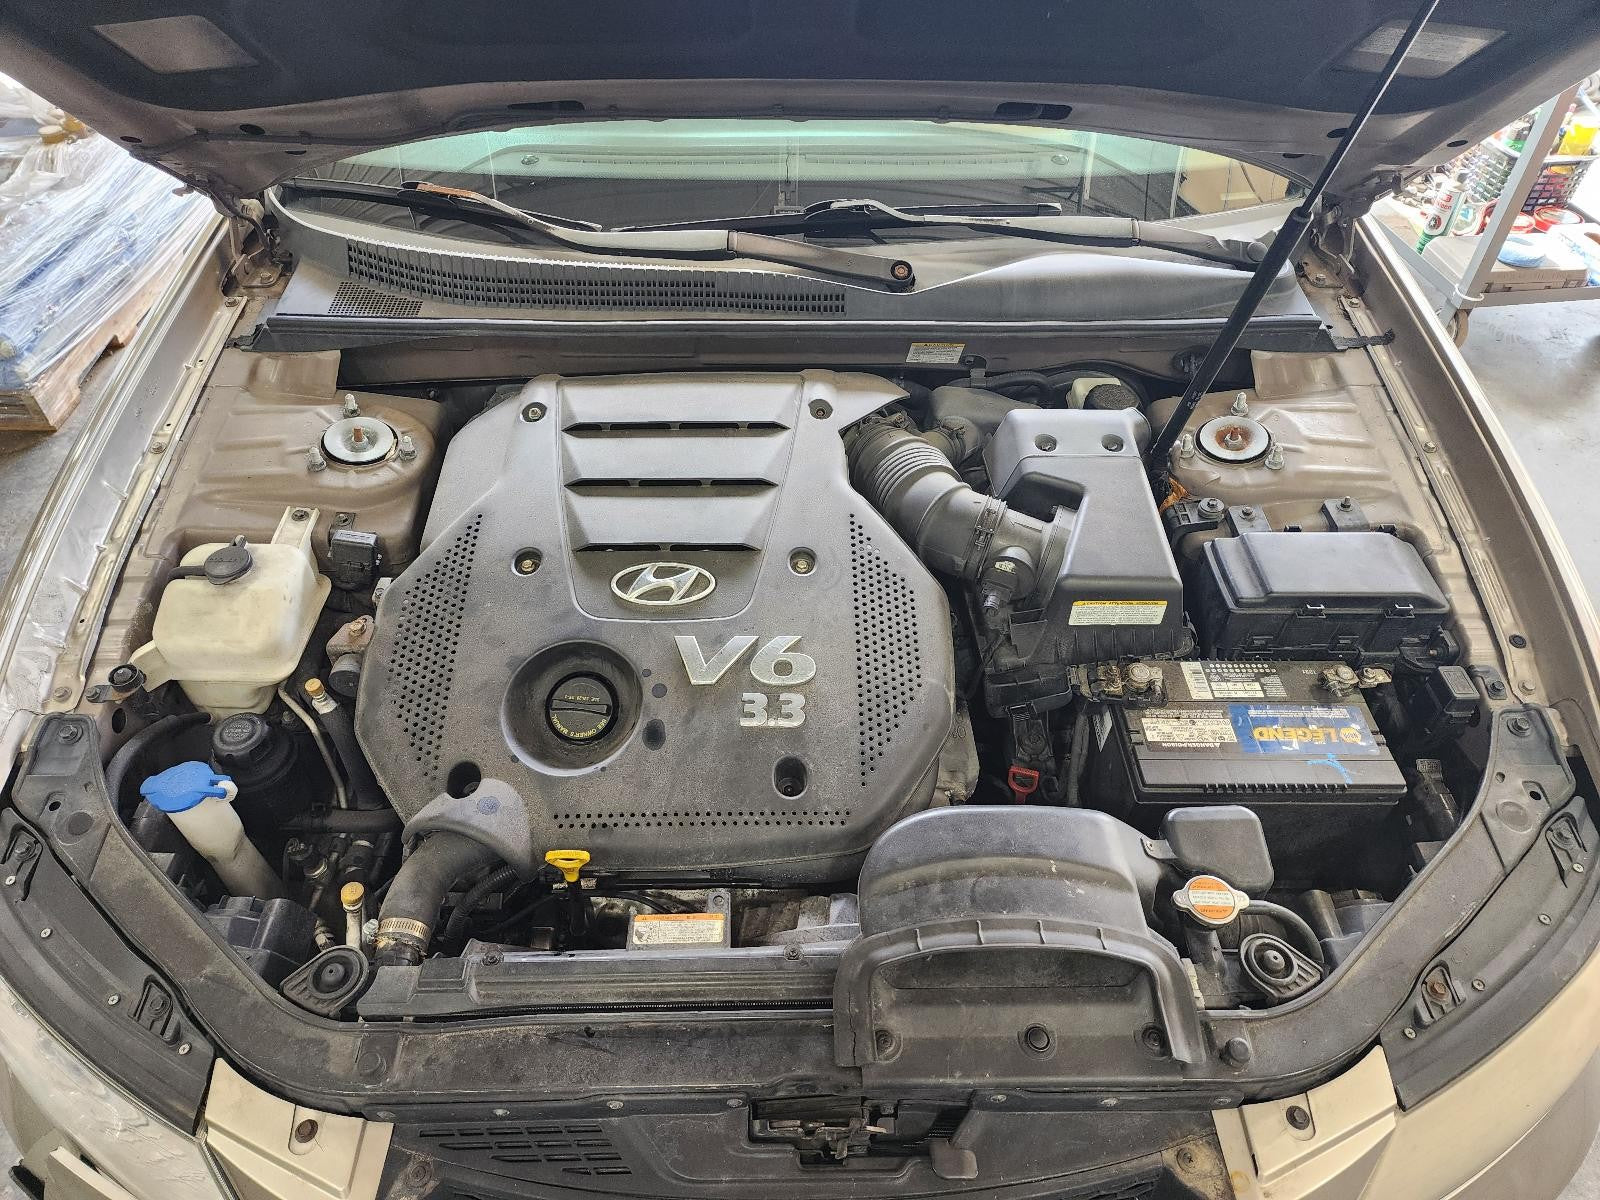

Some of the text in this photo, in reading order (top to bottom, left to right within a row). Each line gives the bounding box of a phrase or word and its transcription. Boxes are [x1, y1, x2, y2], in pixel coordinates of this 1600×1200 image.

[674, 635, 817, 687] V6
[740, 692, 806, 728] 3.3
[551, 714, 607, 738] SEE OWNER'S MANUAL
[1253, 727, 1339, 743] LEGEND
